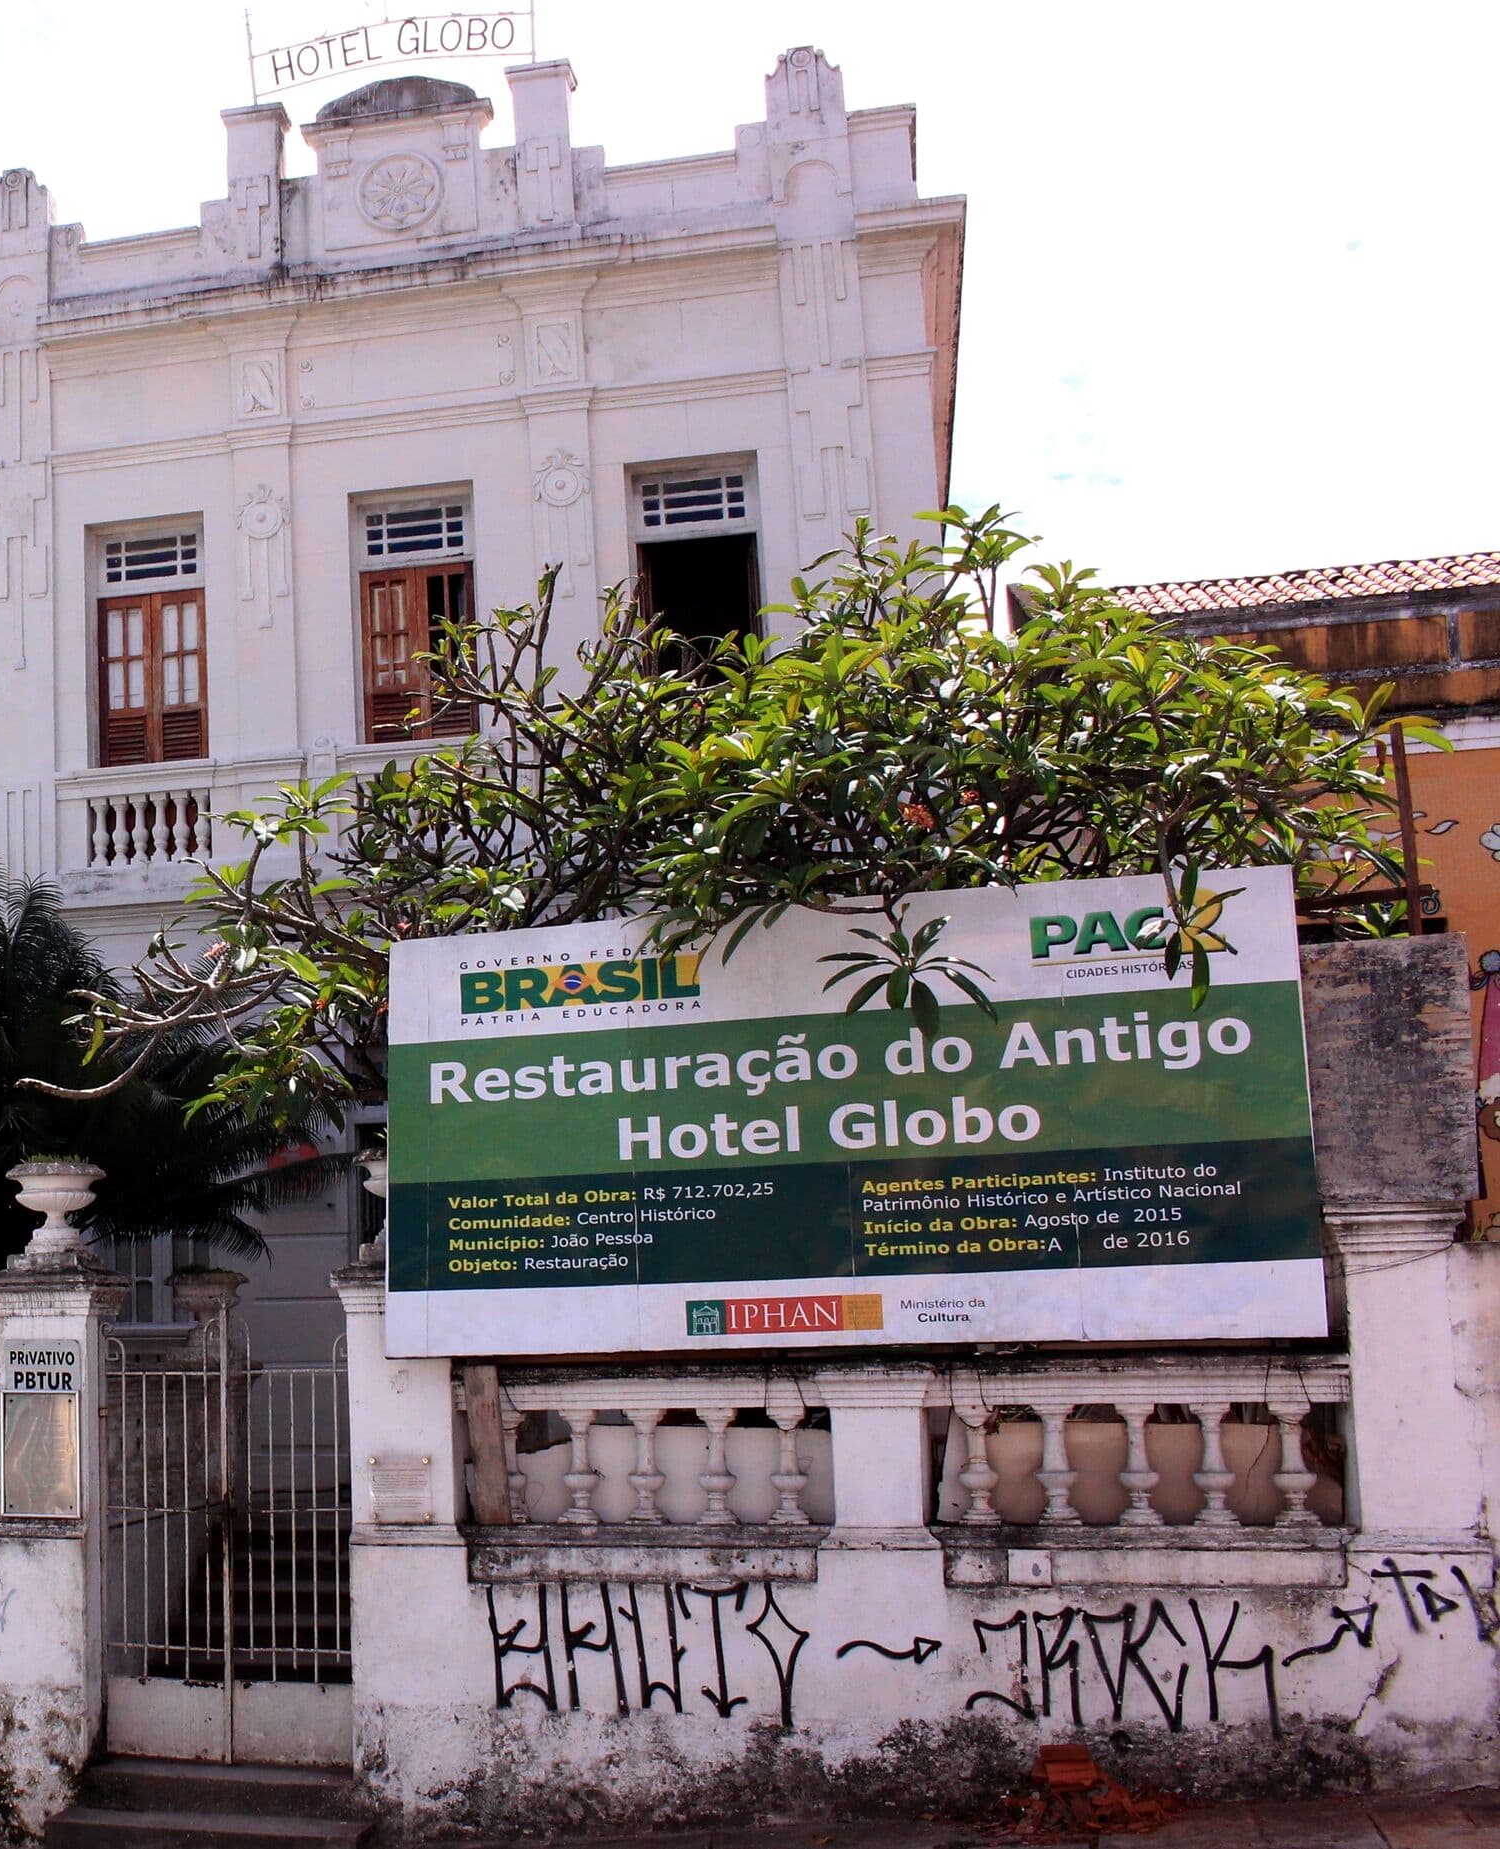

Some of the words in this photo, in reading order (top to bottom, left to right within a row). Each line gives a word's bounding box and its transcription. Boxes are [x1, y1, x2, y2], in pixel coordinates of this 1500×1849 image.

[272, 27, 382, 84] HOTEL
[398, 18, 514, 54] GLOBO
[460, 953, 570, 970] GOVERNO
[1066, 965, 1118, 979] CIDADES
[1121, 960, 1194, 975] HISTÓRAS
[460, 958, 700, 1015] BRASIL
[461, 1012, 540, 1026] PÁTRIA
[563, 1000, 700, 1019] EDUCADORA
[429, 1033, 858, 1104] Restauração
[884, 1027, 972, 1075] do
[999, 1011, 1251, 1070] Antigo
[618, 1106, 801, 1161] Hotel
[828, 1096, 1042, 1150] Globo
[862, 1178, 945, 1196] Agentes
[951, 1171, 1097, 1190] Participantes:
[1104, 1166, 1186, 1181] Instituto
[1193, 1163, 1217, 1177] do
[448, 1196, 498, 1209] Valor
[503, 1192, 549, 1207] Total
[555, 1191, 578, 1205] da
[584, 1189, 637, 1204] Obra:
[643, 1186, 666, 1202] R$
[672, 1182, 774, 1199] 712.702,25
[862, 1195, 960, 1212] Patrimônio
[967, 1192, 1049, 1208] Histórico
[1056, 1191, 1067, 1203] e
[1073, 1186, 1151, 1202] Artístico
[1159, 1181, 1241, 1198] Nacional
[448, 1213, 571, 1231] Comunidade:
[577, 1211, 634, 1226] Centro
[640, 1207, 716, 1223] Histórico
[864, 1219, 923, 1235] Início
[929, 1218, 954, 1232] da
[960, 1216, 1017, 1231] Obra:
[1024, 1213, 1089, 1230] Agosto
[1096, 1211, 1120, 1224] de
[1133, 1207, 1182, 1223] 2015
[448, 1235, 545, 1253] Município:
[551, 1234, 589, 1249] João
[595, 1232, 654, 1246] Pessoa
[864, 1241, 950, 1257] Término
[956, 1240, 981, 1254] da
[988, 1237, 1045, 1253] Obra:
[1103, 1233, 1128, 1250] de
[1136, 1230, 1190, 1248] 2016
[448, 1258, 518, 1275] Objeto:
[524, 1254, 629, 1271] Restauração
[729, 1301, 840, 1329] IPHAN
[900, 1298, 964, 1310] Ministério
[968, 1297, 986, 1308] da
[917, 1312, 969, 1323] Cultura
[14, 1371, 73, 1390] PBTUR
